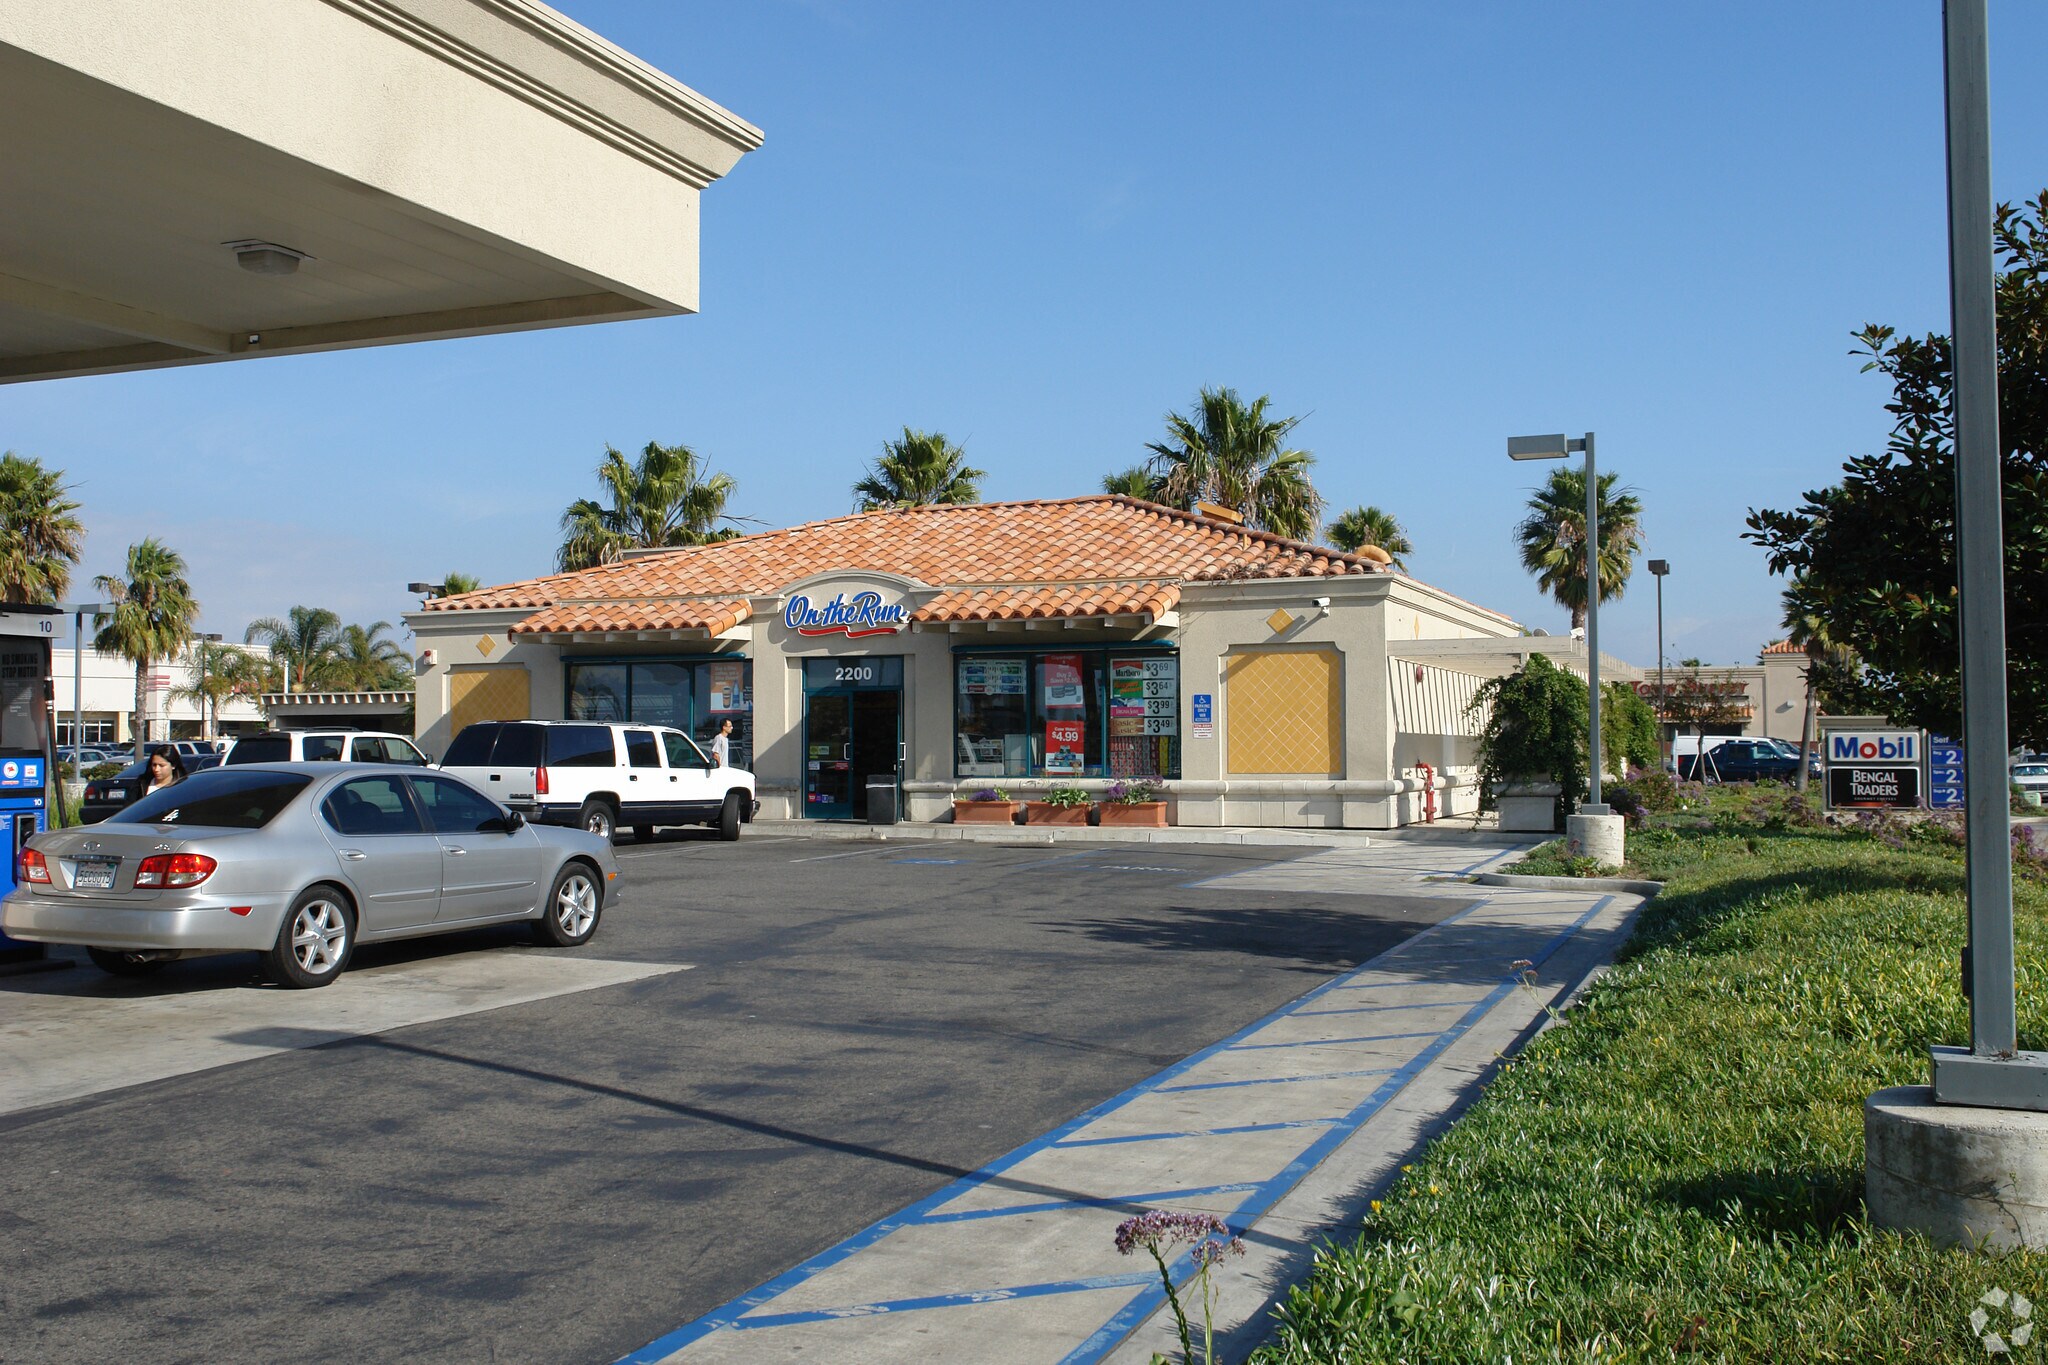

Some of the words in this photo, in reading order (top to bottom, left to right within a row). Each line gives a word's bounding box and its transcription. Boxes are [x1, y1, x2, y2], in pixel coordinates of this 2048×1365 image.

[785, 595, 821, 628] On
[821, 593, 858, 626] the
[851, 591, 909, 628] Run
[39, 620, 53, 633] 10
[2, 654, 10, 665] NO
[11, 653, 38, 665] SMOKING
[2, 667, 17, 678] STOP
[17, 666, 38, 678] MOTOR
[835, 667, 873, 680] 2200
[1115, 669, 1141, 677] Marlboro
[1051, 731, 1079, 742] $4.99
[1933, 736, 1949, 744] Self
[1834, 736, 1913, 759] Mobil
[1852, 770, 1898, 783] BENGAL
[1850, 783, 1899, 796] TRADERS
[33, 798, 43, 806] 10
